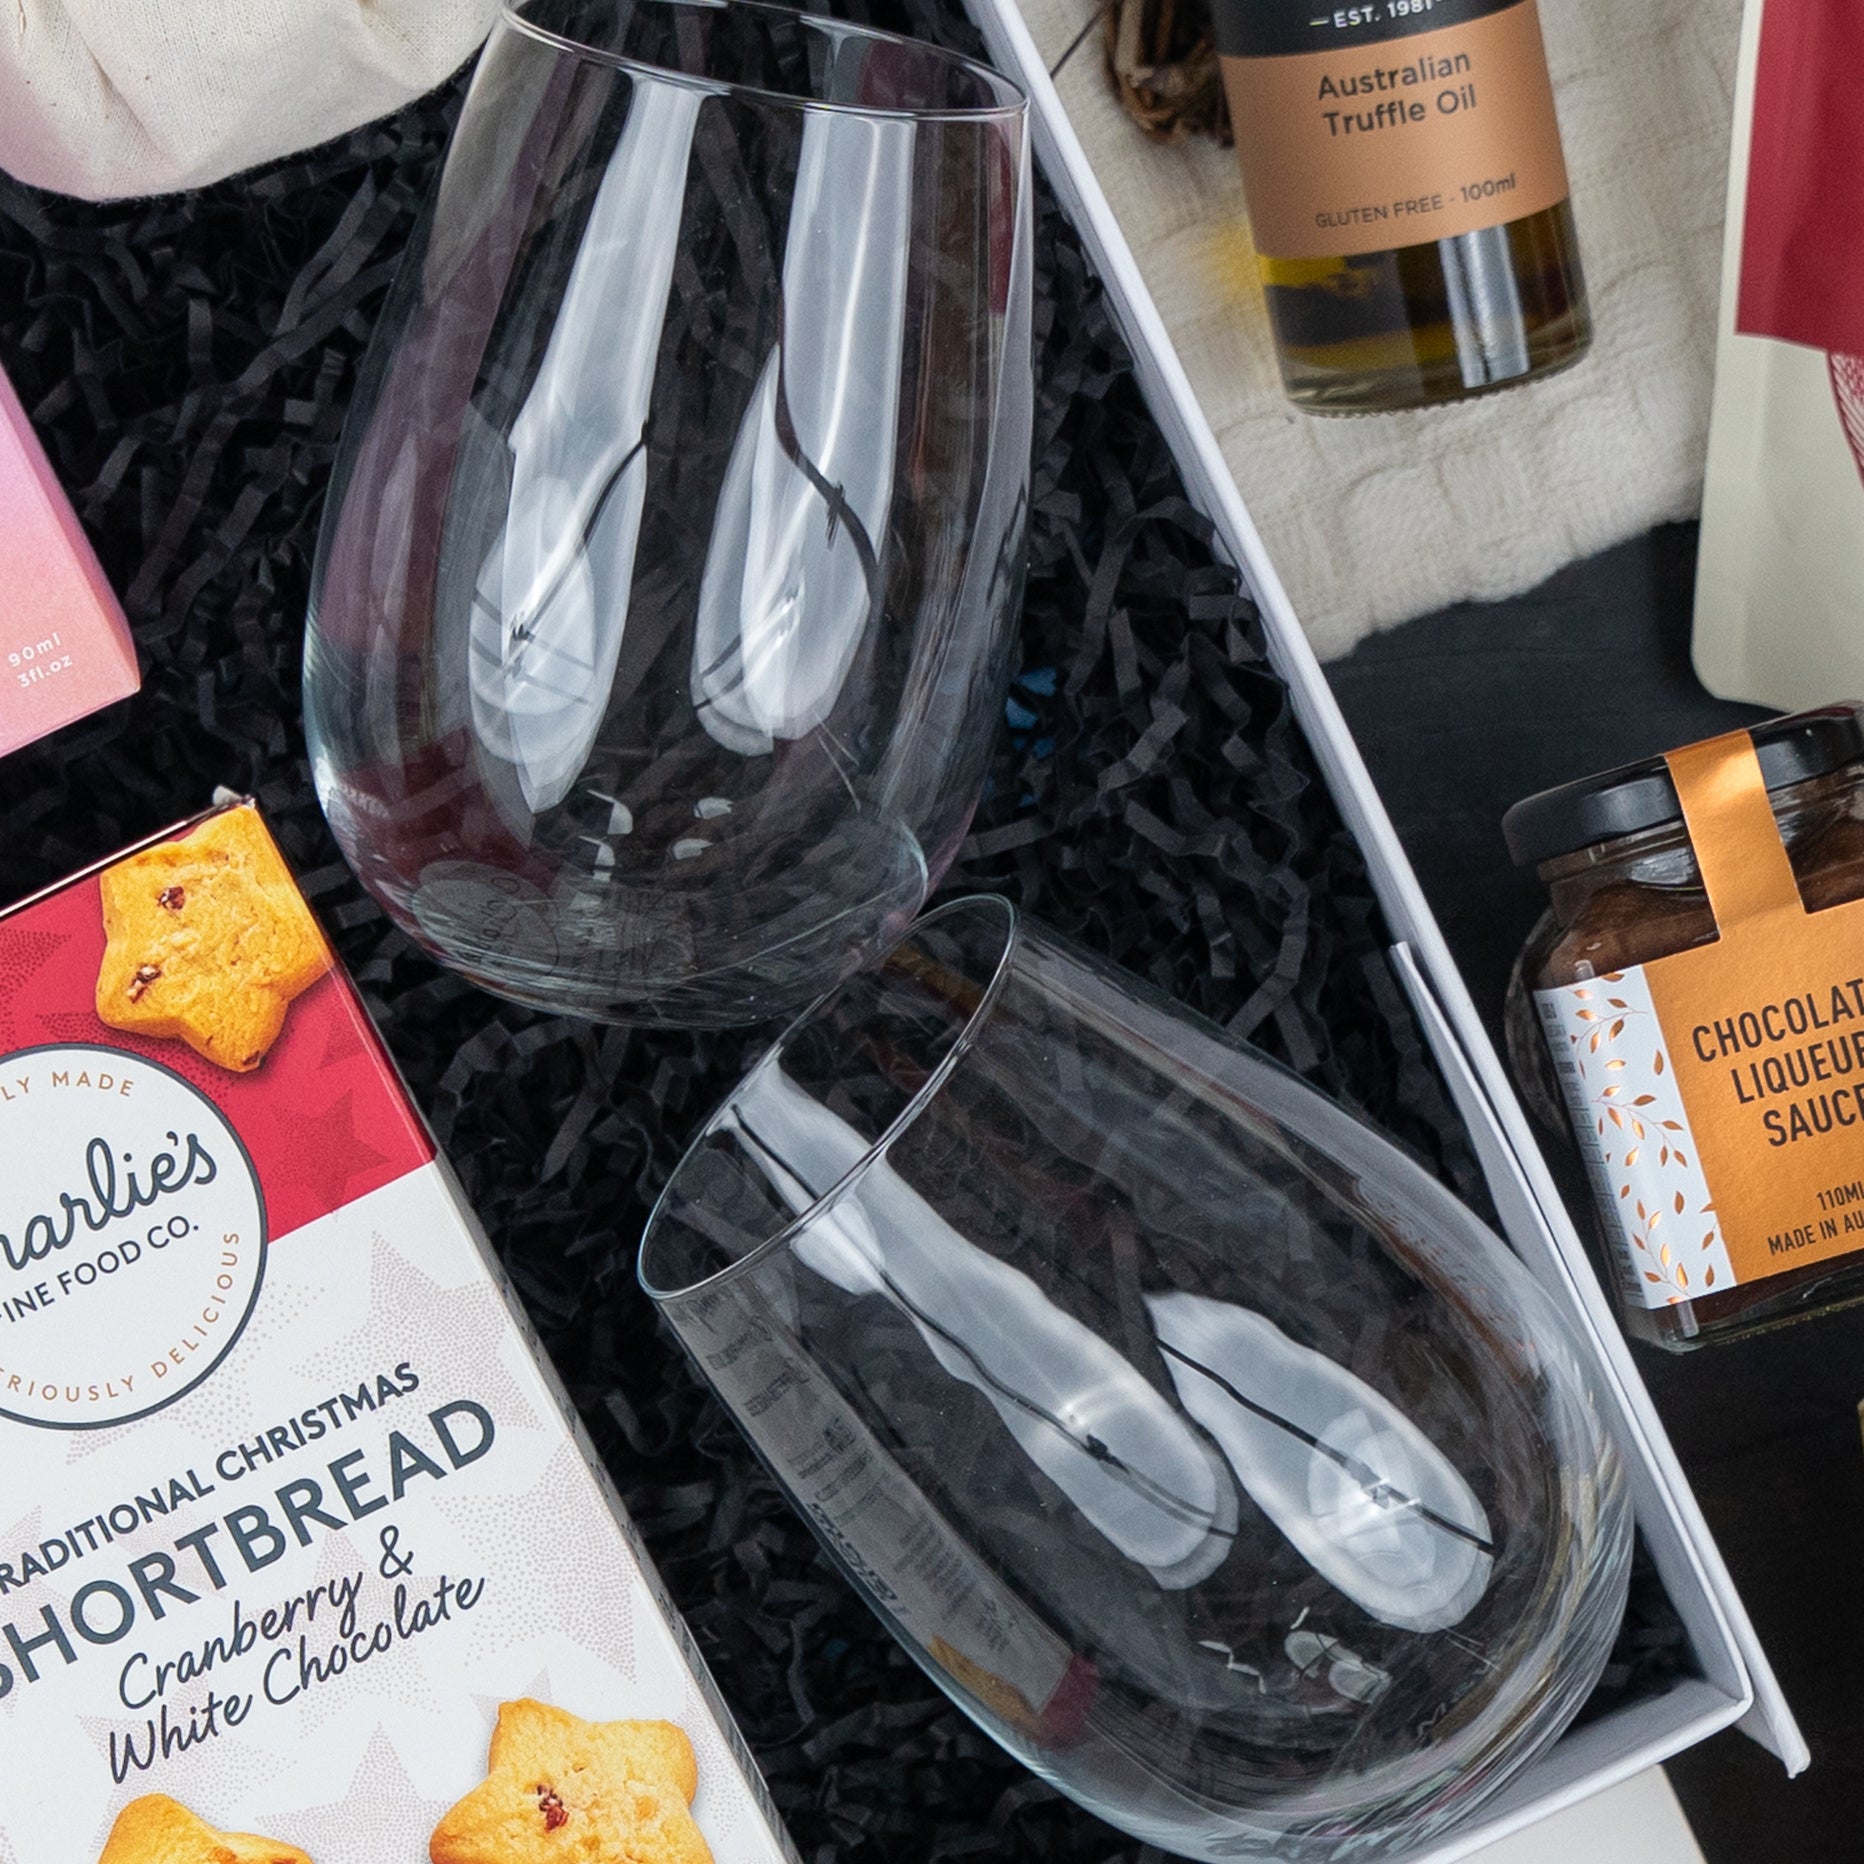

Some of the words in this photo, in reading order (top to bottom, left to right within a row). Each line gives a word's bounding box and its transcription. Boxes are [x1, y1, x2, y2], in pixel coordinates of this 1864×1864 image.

[1333, 6, 1381, 28] EST.
[1318, 53, 1471, 100] Australian
[1322, 100, 1426, 137] Truffle
[1437, 84, 1477, 115] Oil
[1315, 206, 1388, 228] GLUTEN
[1393, 194, 1444, 219] FREE
[1460, 172, 1517, 202] 100ml
[8, 632, 61, 667] 90ml
[52, 1071, 134, 1097] MADE
[1767, 1224, 1816, 1256] MADE
[1819, 1218, 1838, 1240] IN
[0, 1282, 55, 1323] INE
[57, 1240, 141, 1296] FOOD
[147, 1215, 199, 1249] CO.
[0, 1367, 133, 1402] RIOUSLY
[151, 1233, 240, 1379] DELICIOUS
[215, 1362, 420, 1481] CHRISTMAS
[119, 1571, 363, 1710] Cranberry
[378, 1525, 414, 1579] &
[109, 1691, 253, 1784] White
[263, 1574, 486, 1705] Chocolate
